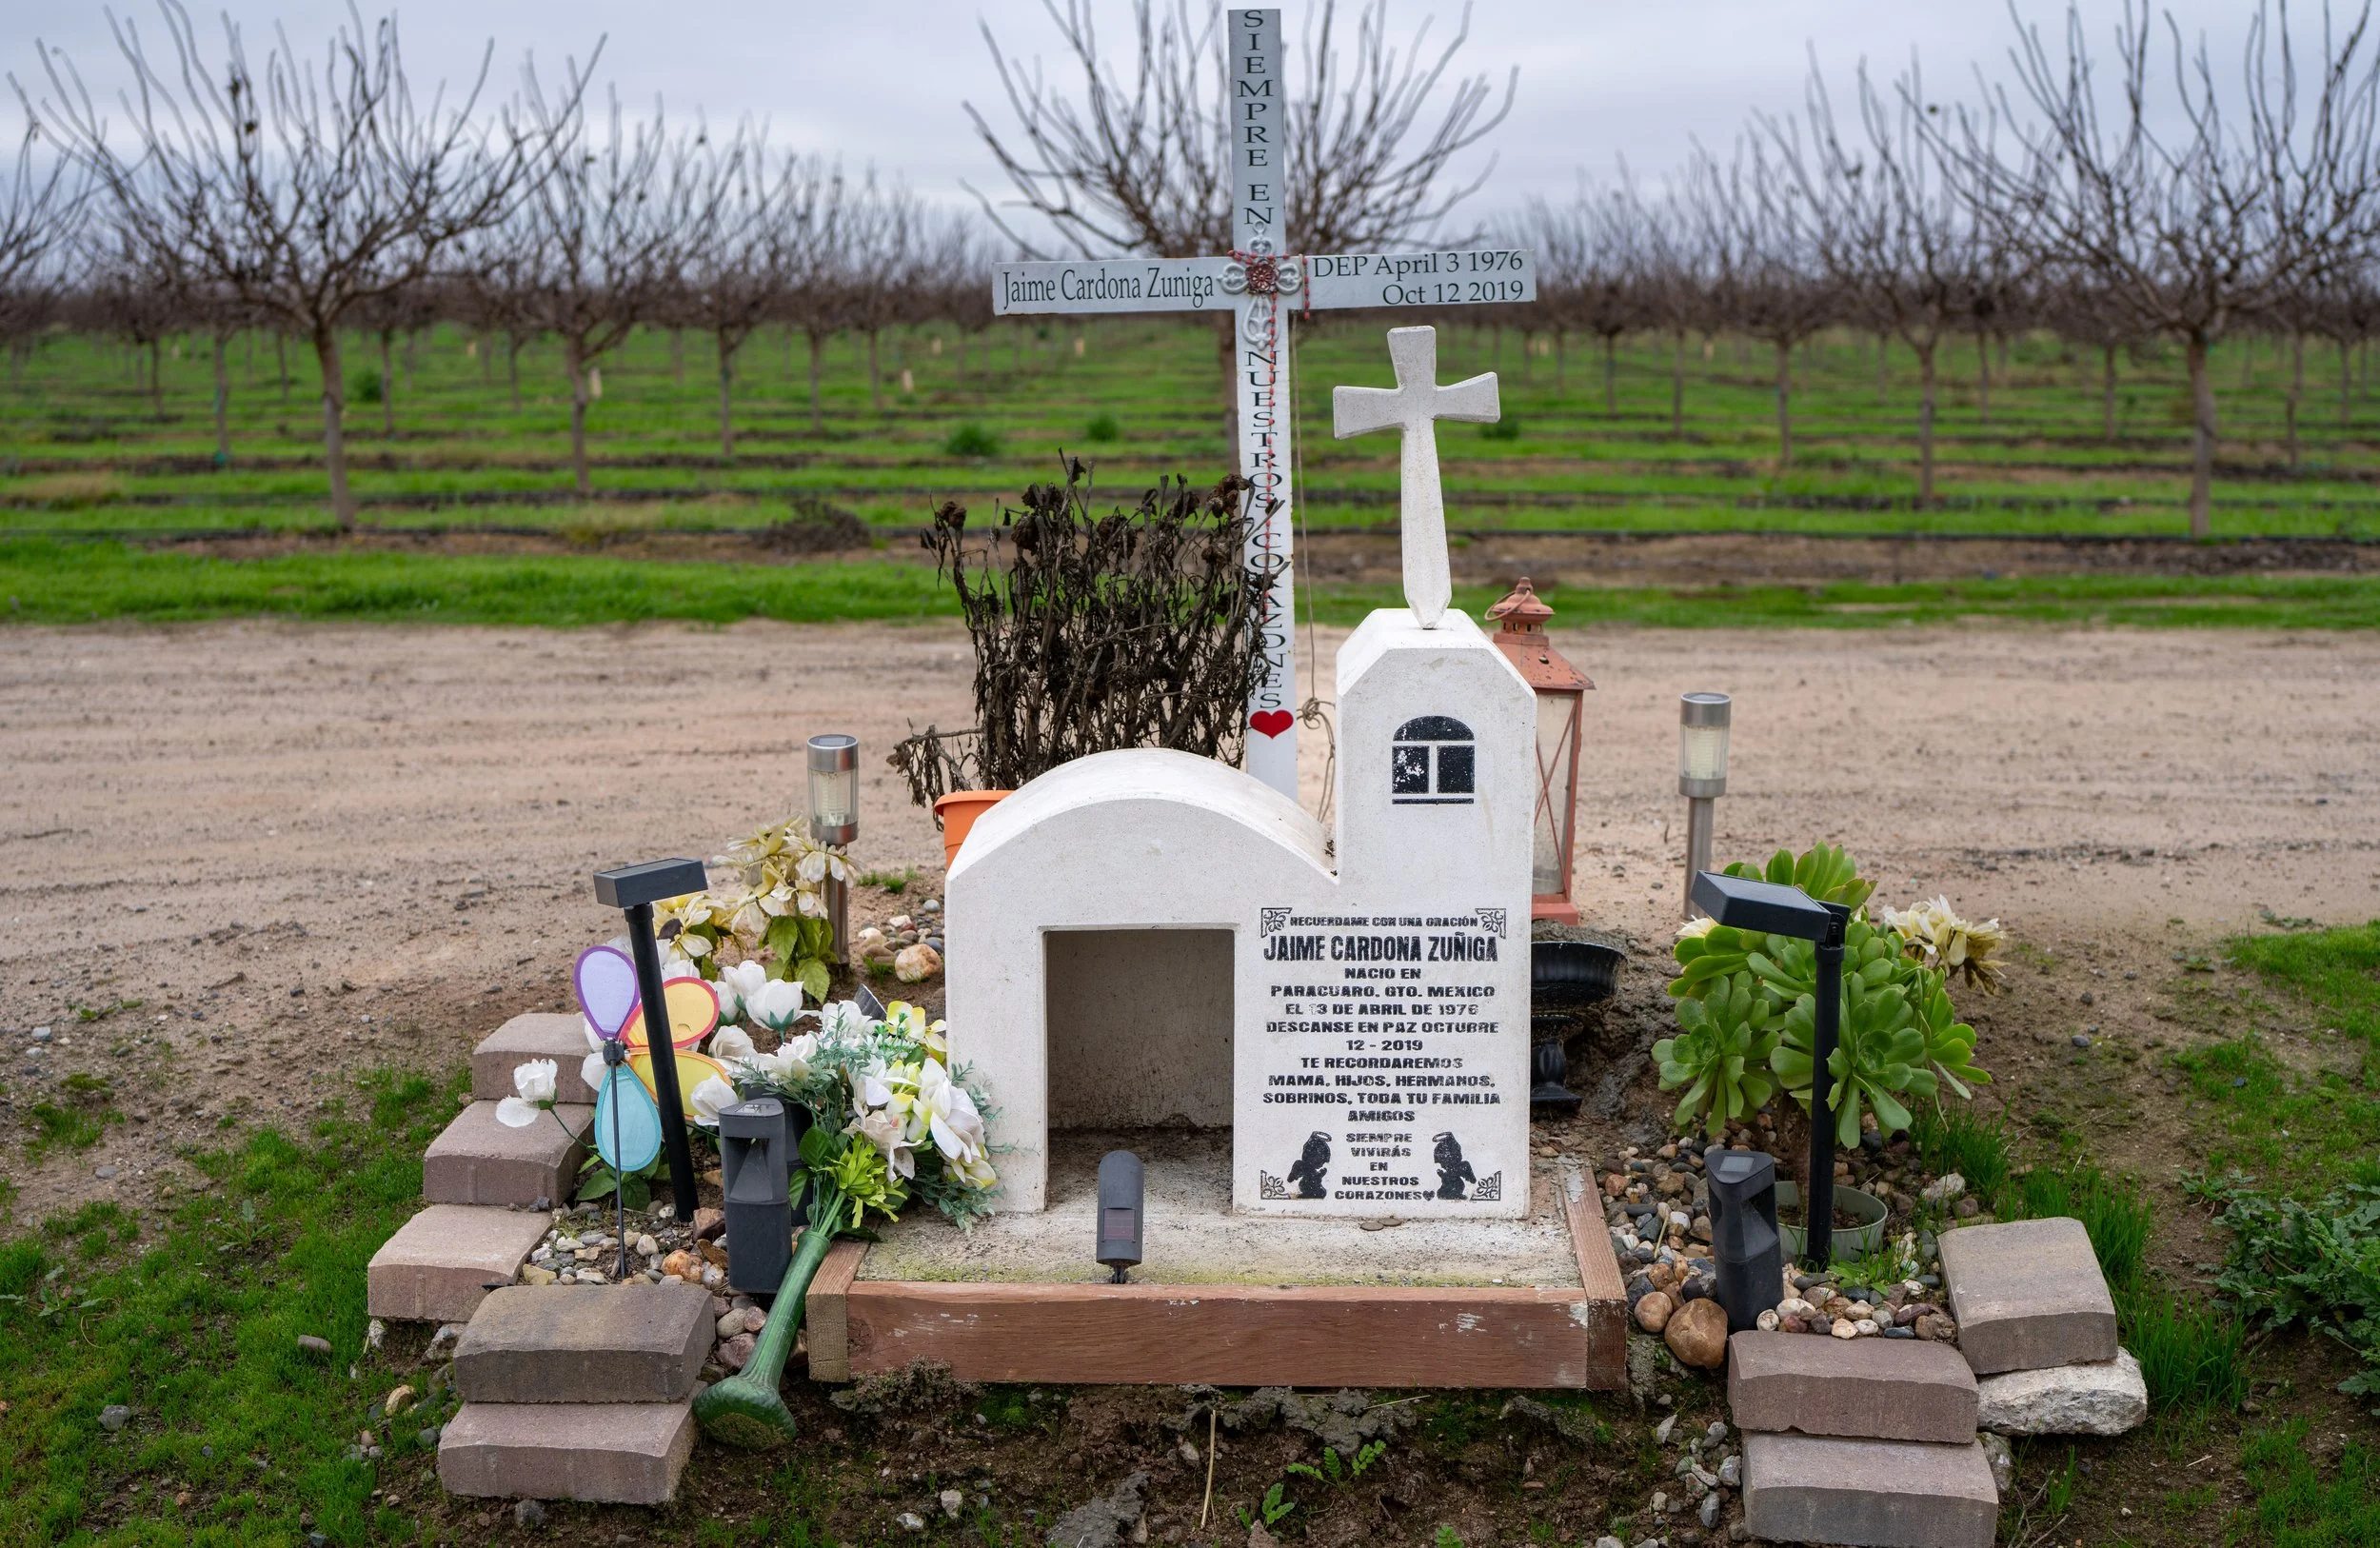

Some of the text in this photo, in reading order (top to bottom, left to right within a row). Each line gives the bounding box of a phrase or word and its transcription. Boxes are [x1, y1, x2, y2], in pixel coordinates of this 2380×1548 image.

[1238, 10, 1274, 167] SIEMPRE
[1243, 184, 1275, 225] EN
[1314, 251, 1522, 278] DEP April 3 1976
[1002, 267, 1215, 308] Jaime Cardona Zuniga
[1381, 280, 1523, 306] Oct 12 2019
[1244, 350, 1282, 507] NUESTROS
[1289, 916, 1478, 927] RECUERDAME CON UNA ORACIÓN
[1263, 931, 1498, 963] JAIME CARDONA ZUÑIGA
[1344, 967, 1421, 980] NACIO EN
[1384, 985, 1423, 998] GTO.
[1427, 985, 1496, 998] MEXICO
[1285, 1003, 1304, 1015] EL
[1332, 1003, 1354, 1015] DE
[1358, 1003, 1407, 1016] ABRIL
[1411, 1003, 1433, 1016] DE
[1438, 1003, 1478, 1016] 1976
[1266, 1021, 1499, 1034] DESCANSE EN PAZ OCTUBRE
[1345, 1040, 1365, 1051] 12
[1381, 1040, 1423, 1051] 2019
[1300, 1057, 1463, 1069] TE RECORDAREMOS
[1335, 1074, 1392, 1087] HIJOS,
[1262, 1092, 1501, 1105] SOBRINOS, TODA TU FAMILIA
[1347, 1110, 1416, 1122] AMIGOS
[1345, 1133, 1413, 1143] SIEMPRE
[1350, 1144, 1411, 1158] VIVIRÁS
[1369, 1161, 1388, 1172] EN
[1341, 1176, 1419, 1186] NUESTROS
[1334, 1190, 1424, 1201] CORAZONES
